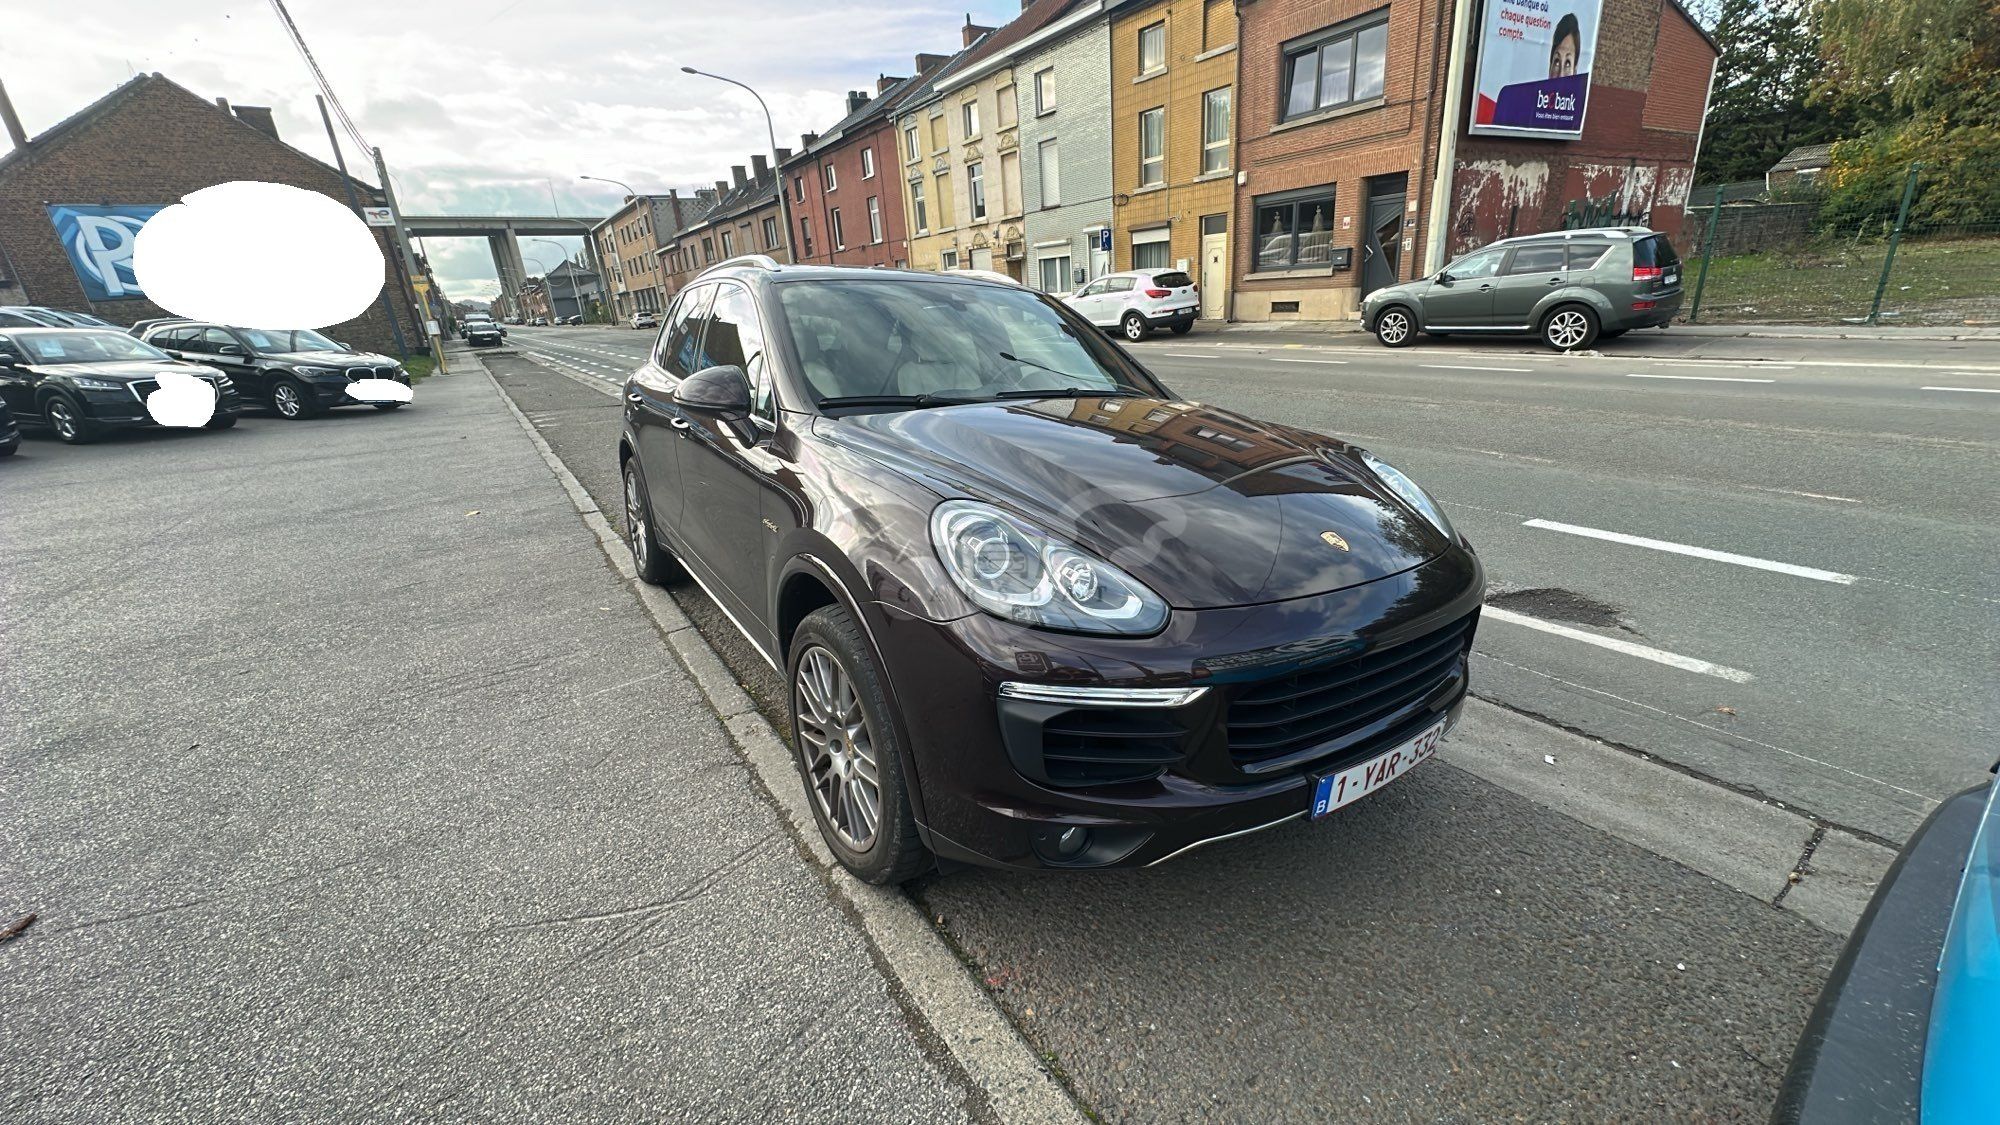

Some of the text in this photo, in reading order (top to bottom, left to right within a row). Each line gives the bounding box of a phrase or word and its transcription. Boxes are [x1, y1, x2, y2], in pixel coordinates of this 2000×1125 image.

[1501, 8, 1551, 29] chaque question
[1499, 26, 1525, 41] compte.
[1102, 230, 1109, 243] P
[1337, 726, 1441, 803] 1-YAR-332
[1316, 800, 1326, 814] B
